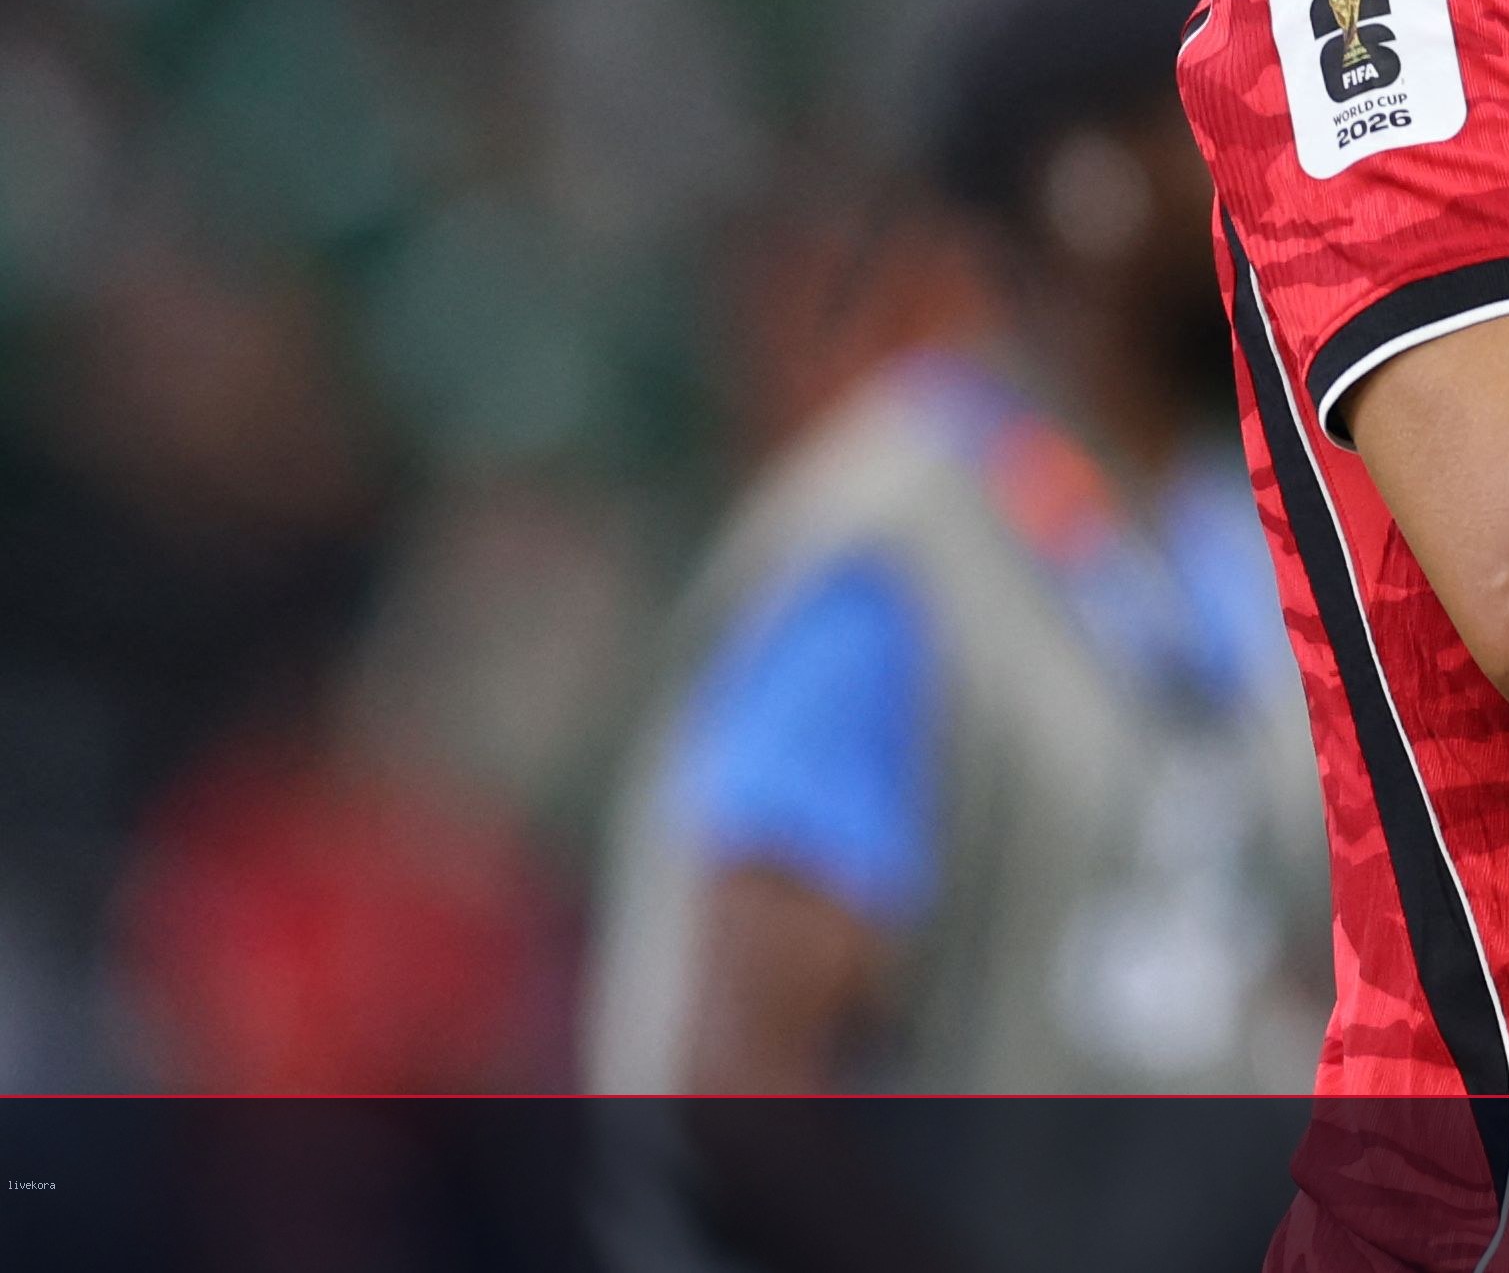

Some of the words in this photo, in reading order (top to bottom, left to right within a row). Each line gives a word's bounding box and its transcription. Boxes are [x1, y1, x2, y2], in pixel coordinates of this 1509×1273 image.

[1341, 62, 1380, 90] FIFA
[1333, 100, 1374, 126] WORLD
[1377, 93, 1408, 107] CUP
[1336, 108, 1412, 149] 2026
